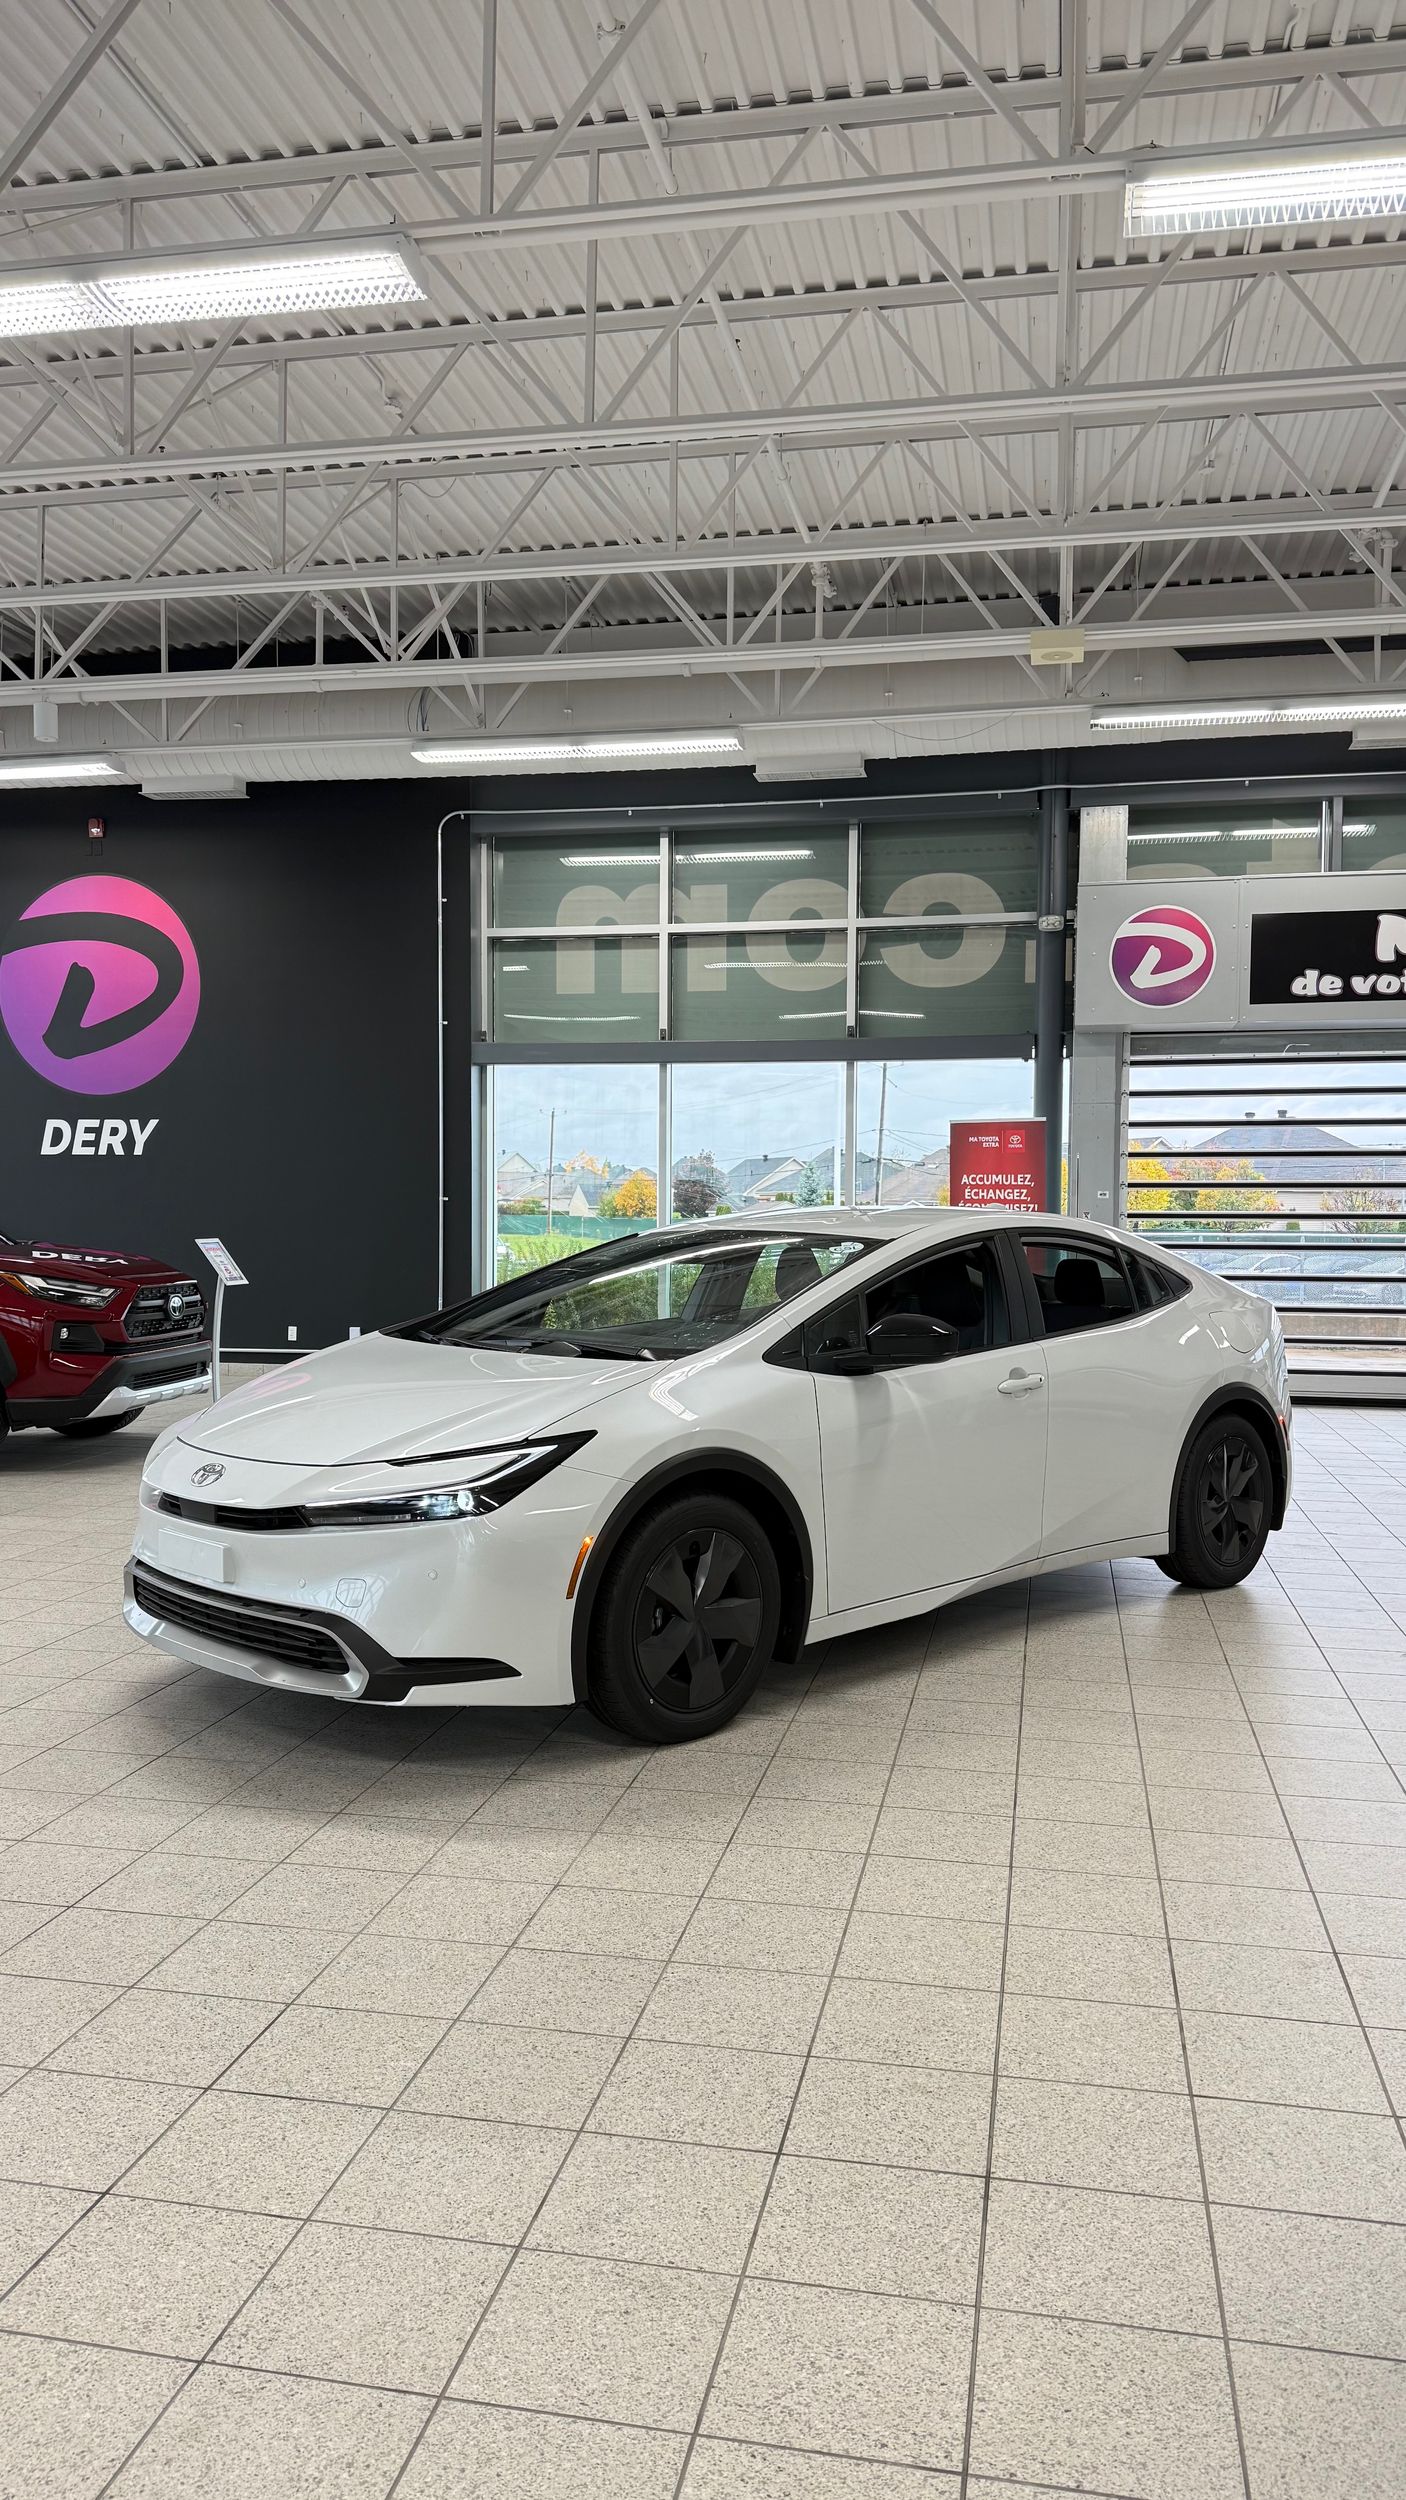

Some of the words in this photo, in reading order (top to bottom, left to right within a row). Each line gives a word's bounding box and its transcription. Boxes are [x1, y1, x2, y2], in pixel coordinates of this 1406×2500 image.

[1290, 968, 1344, 997] de
[40, 1118, 159, 1156] DERY
[960, 1174, 1035, 1187] ACCUMULEZ,
[964, 1186, 1031, 1202] ÉCHANGEZ,
